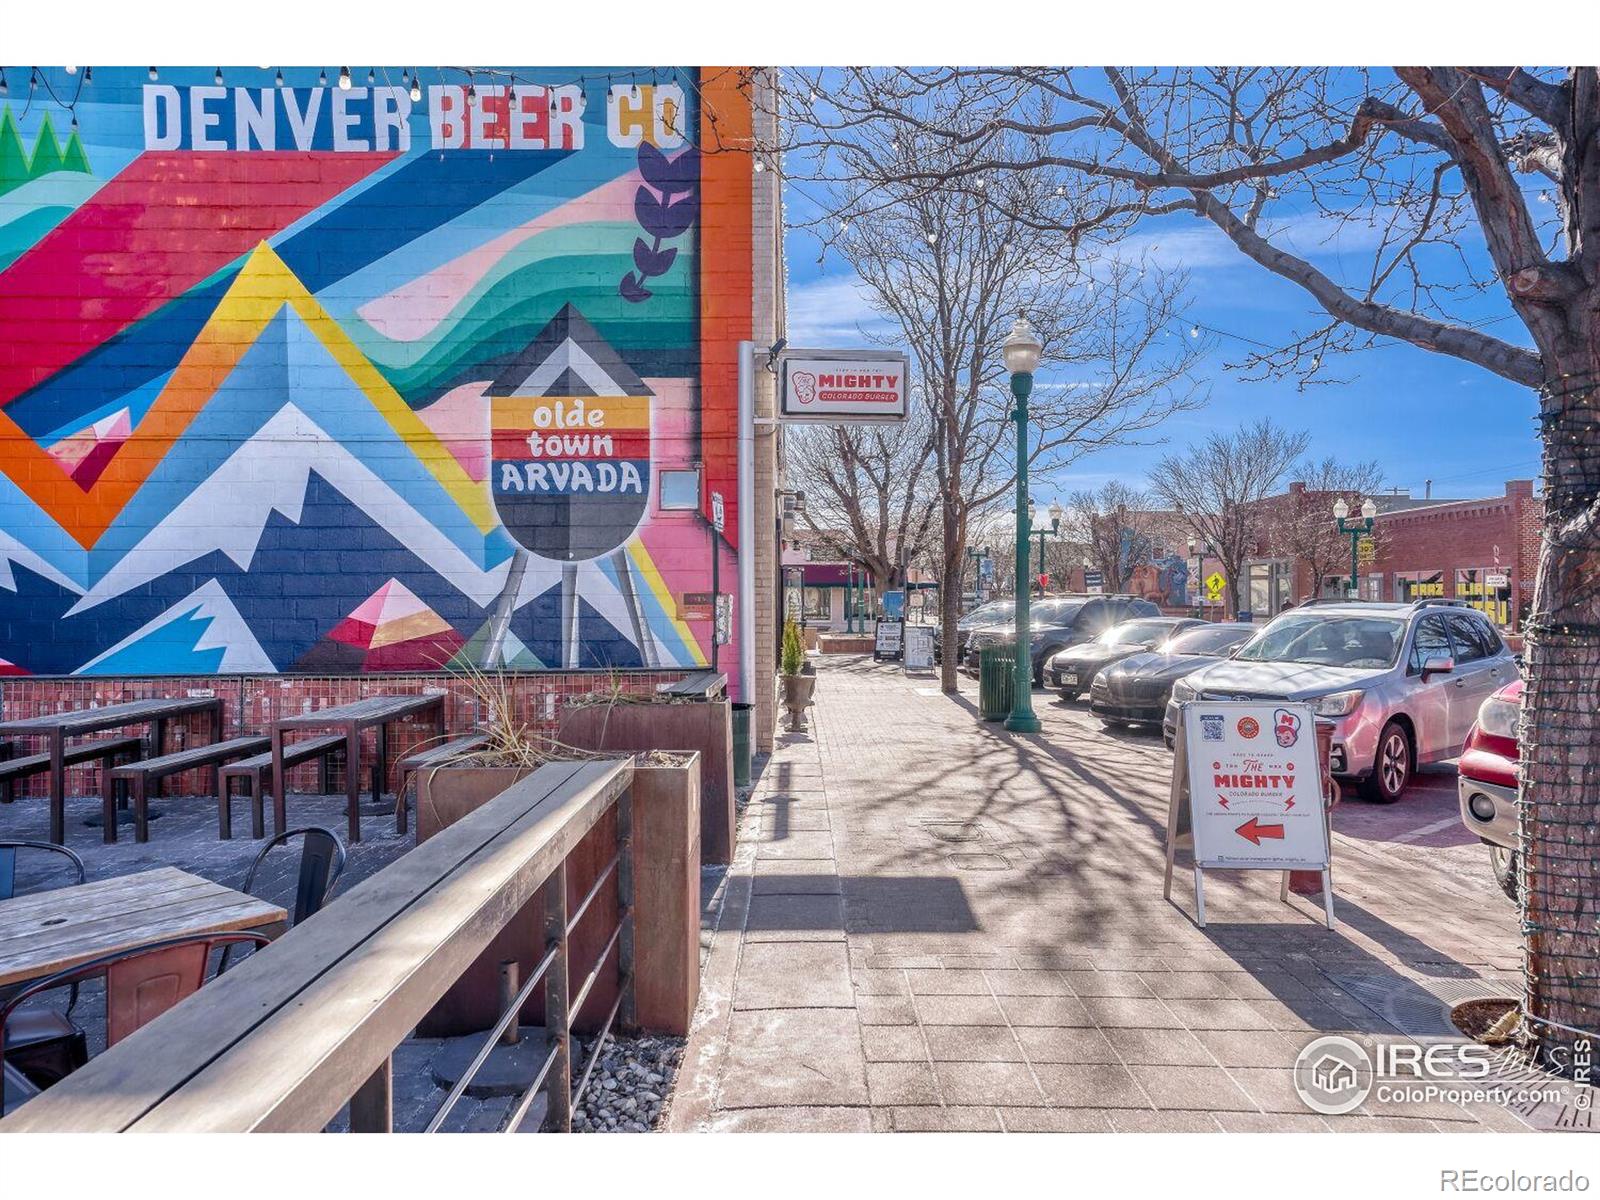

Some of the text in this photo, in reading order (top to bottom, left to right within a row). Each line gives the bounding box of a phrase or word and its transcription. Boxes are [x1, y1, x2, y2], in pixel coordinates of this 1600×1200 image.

[143, 84, 686, 152] DENVER BEER CO
[818, 374, 899, 389] MIGHTY
[821, 392, 864, 400] COLORADO
[526, 430, 614, 458] town
[501, 461, 643, 494] ARVADA
[1242, 759, 1265, 773] THE
[1213, 774, 1296, 789] MIGHTY
